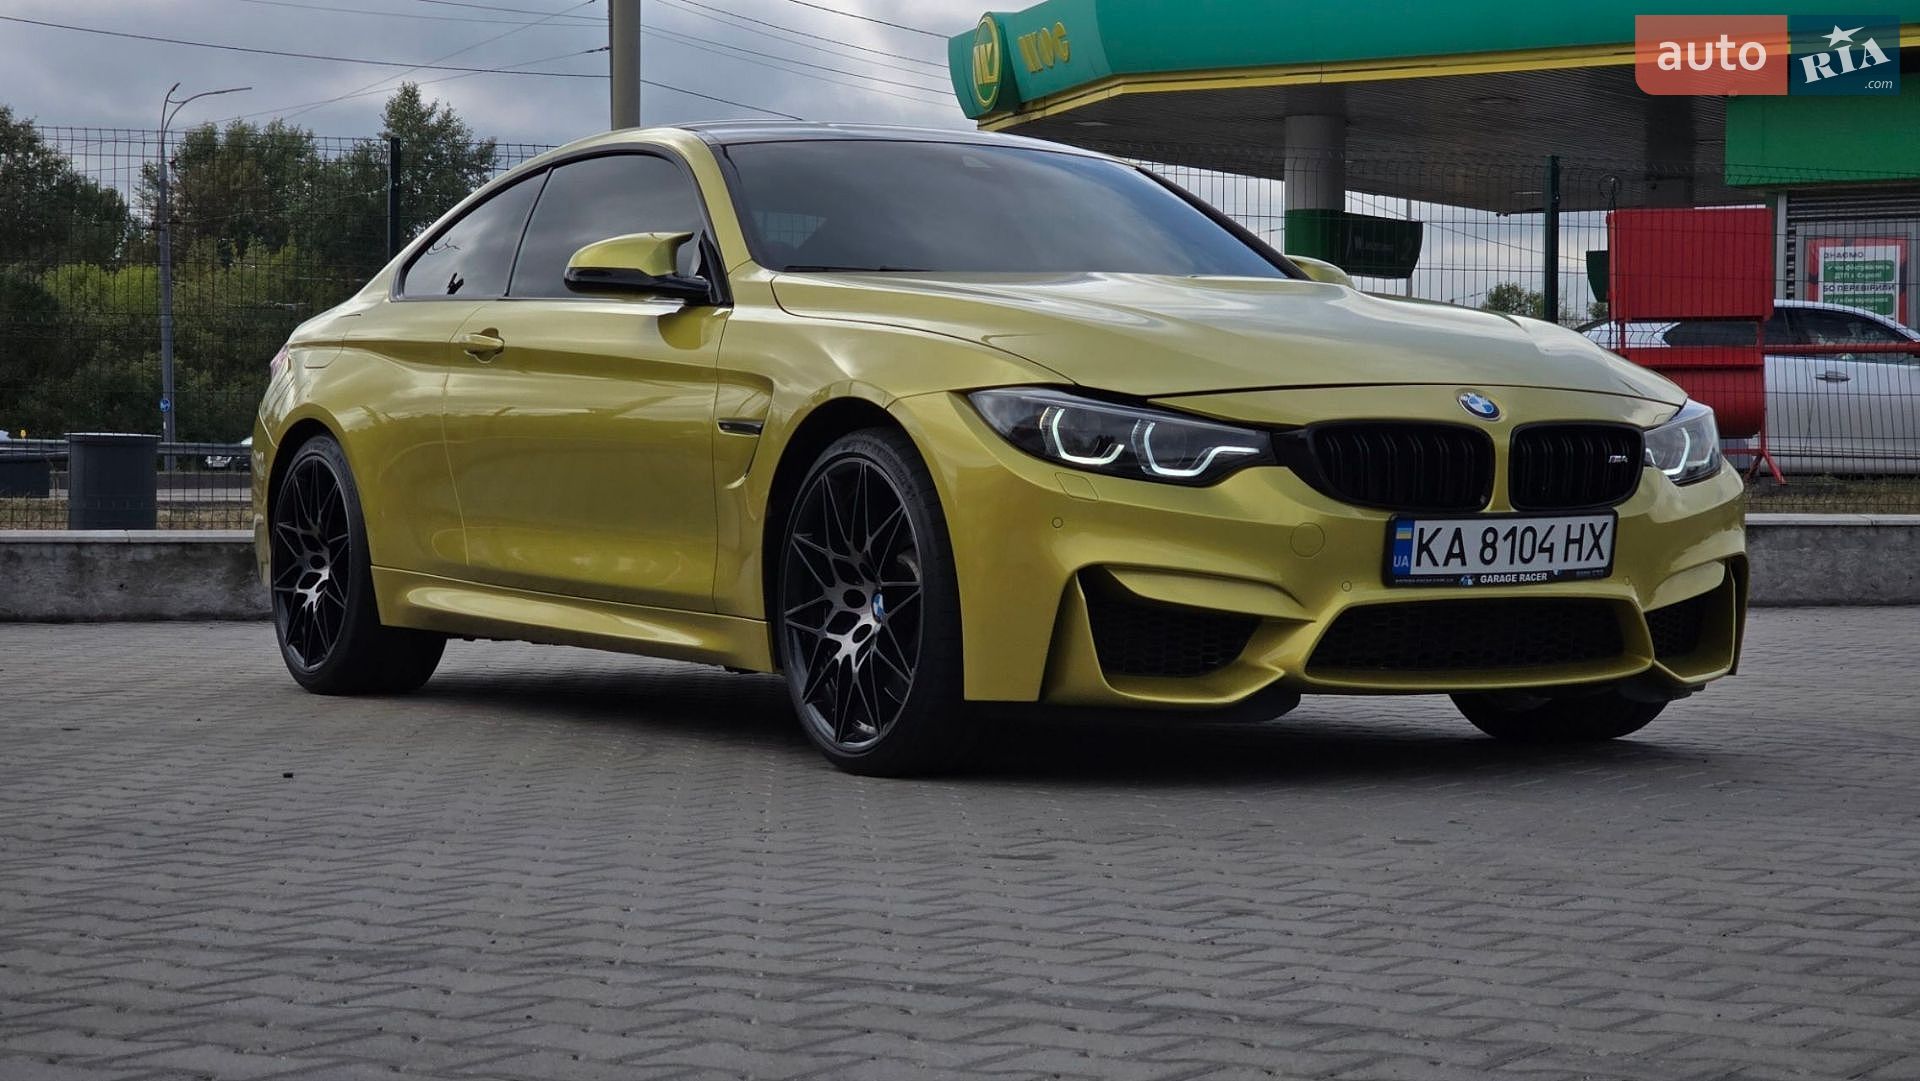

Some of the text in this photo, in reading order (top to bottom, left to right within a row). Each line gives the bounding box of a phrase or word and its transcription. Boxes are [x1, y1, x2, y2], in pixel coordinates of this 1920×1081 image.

[1415, 522, 1609, 568] KA 8104 HX
[1393, 555, 1409, 568] UA
[1480, 572, 1548, 584] GARAGE RACER
